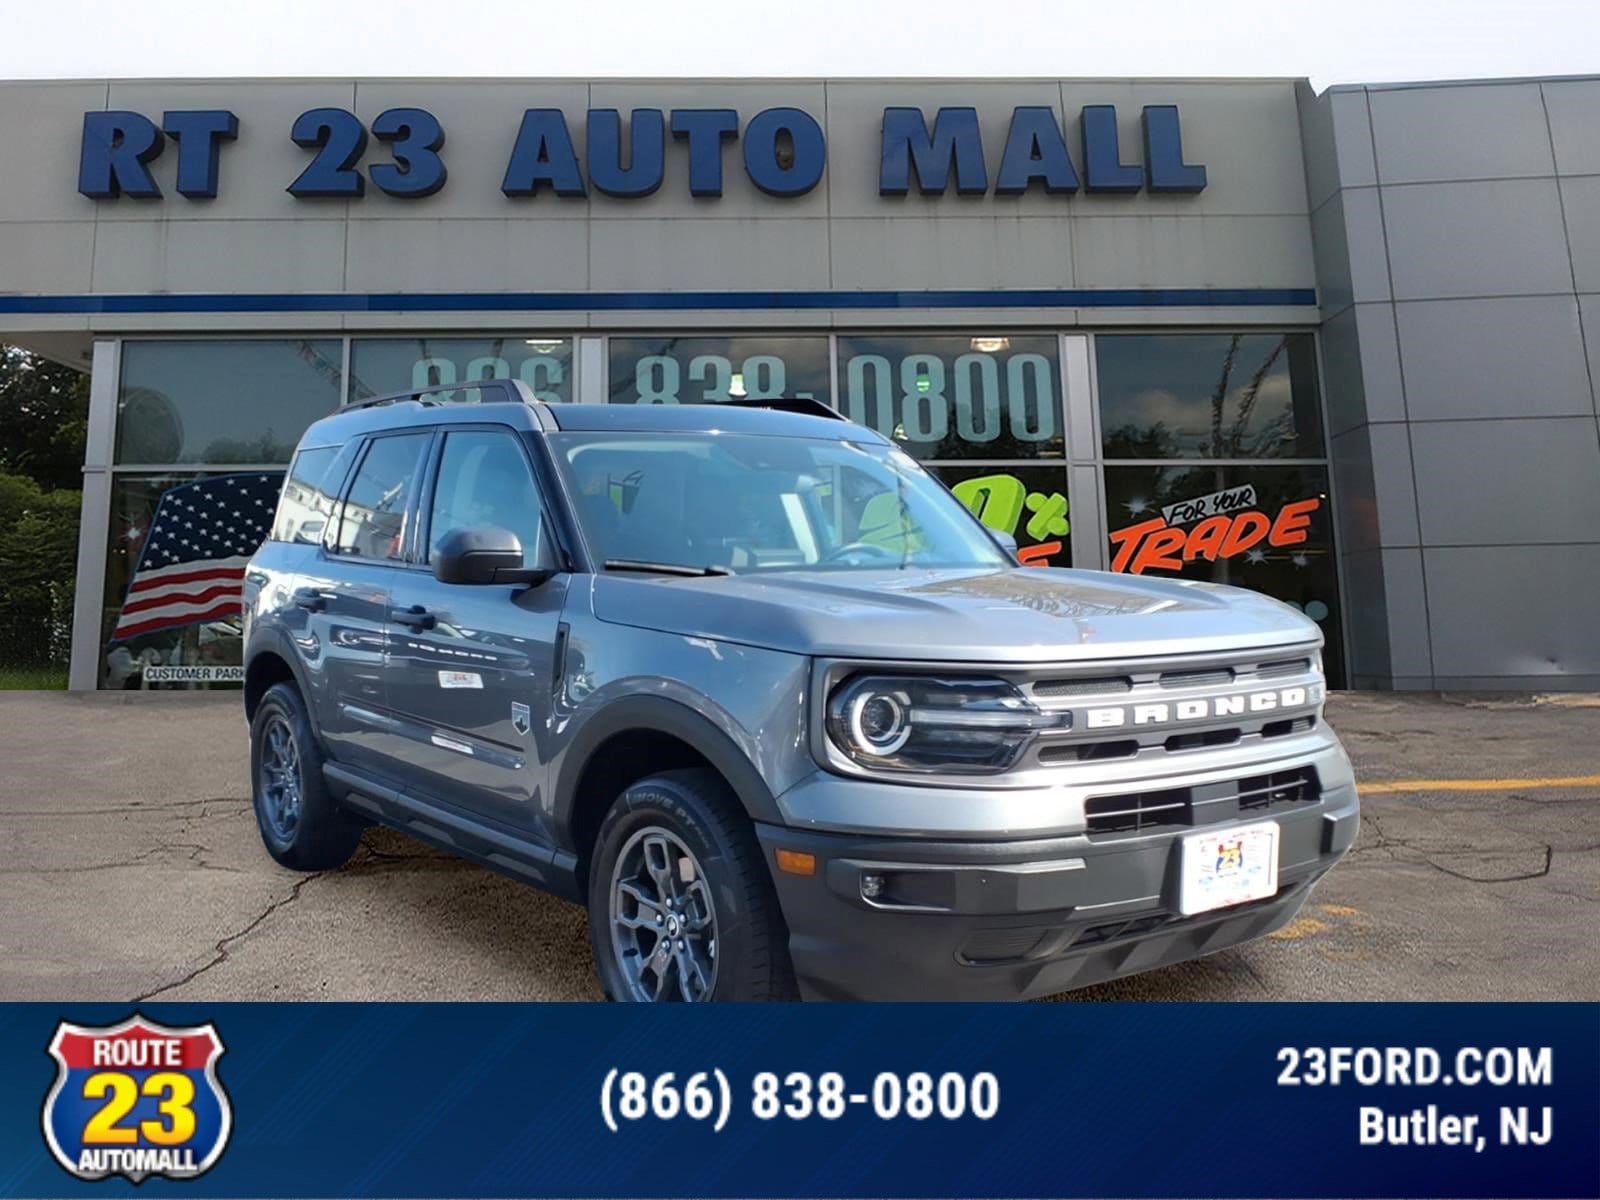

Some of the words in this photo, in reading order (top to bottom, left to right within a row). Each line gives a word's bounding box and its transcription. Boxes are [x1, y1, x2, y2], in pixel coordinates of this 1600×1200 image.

[78, 110, 238, 199] RT
[287, 107, 448, 198] 23
[502, 107, 826, 198] AUTO
[879, 105, 1207, 196] MALL
[1169, 499, 1207, 525] FOR
[1213, 487, 1253, 512] YOUR
[1109, 498, 1321, 575] TRADE
[145, 667, 210, 680] CUSTOMER
[1087, 687, 1306, 729] BRONCO
